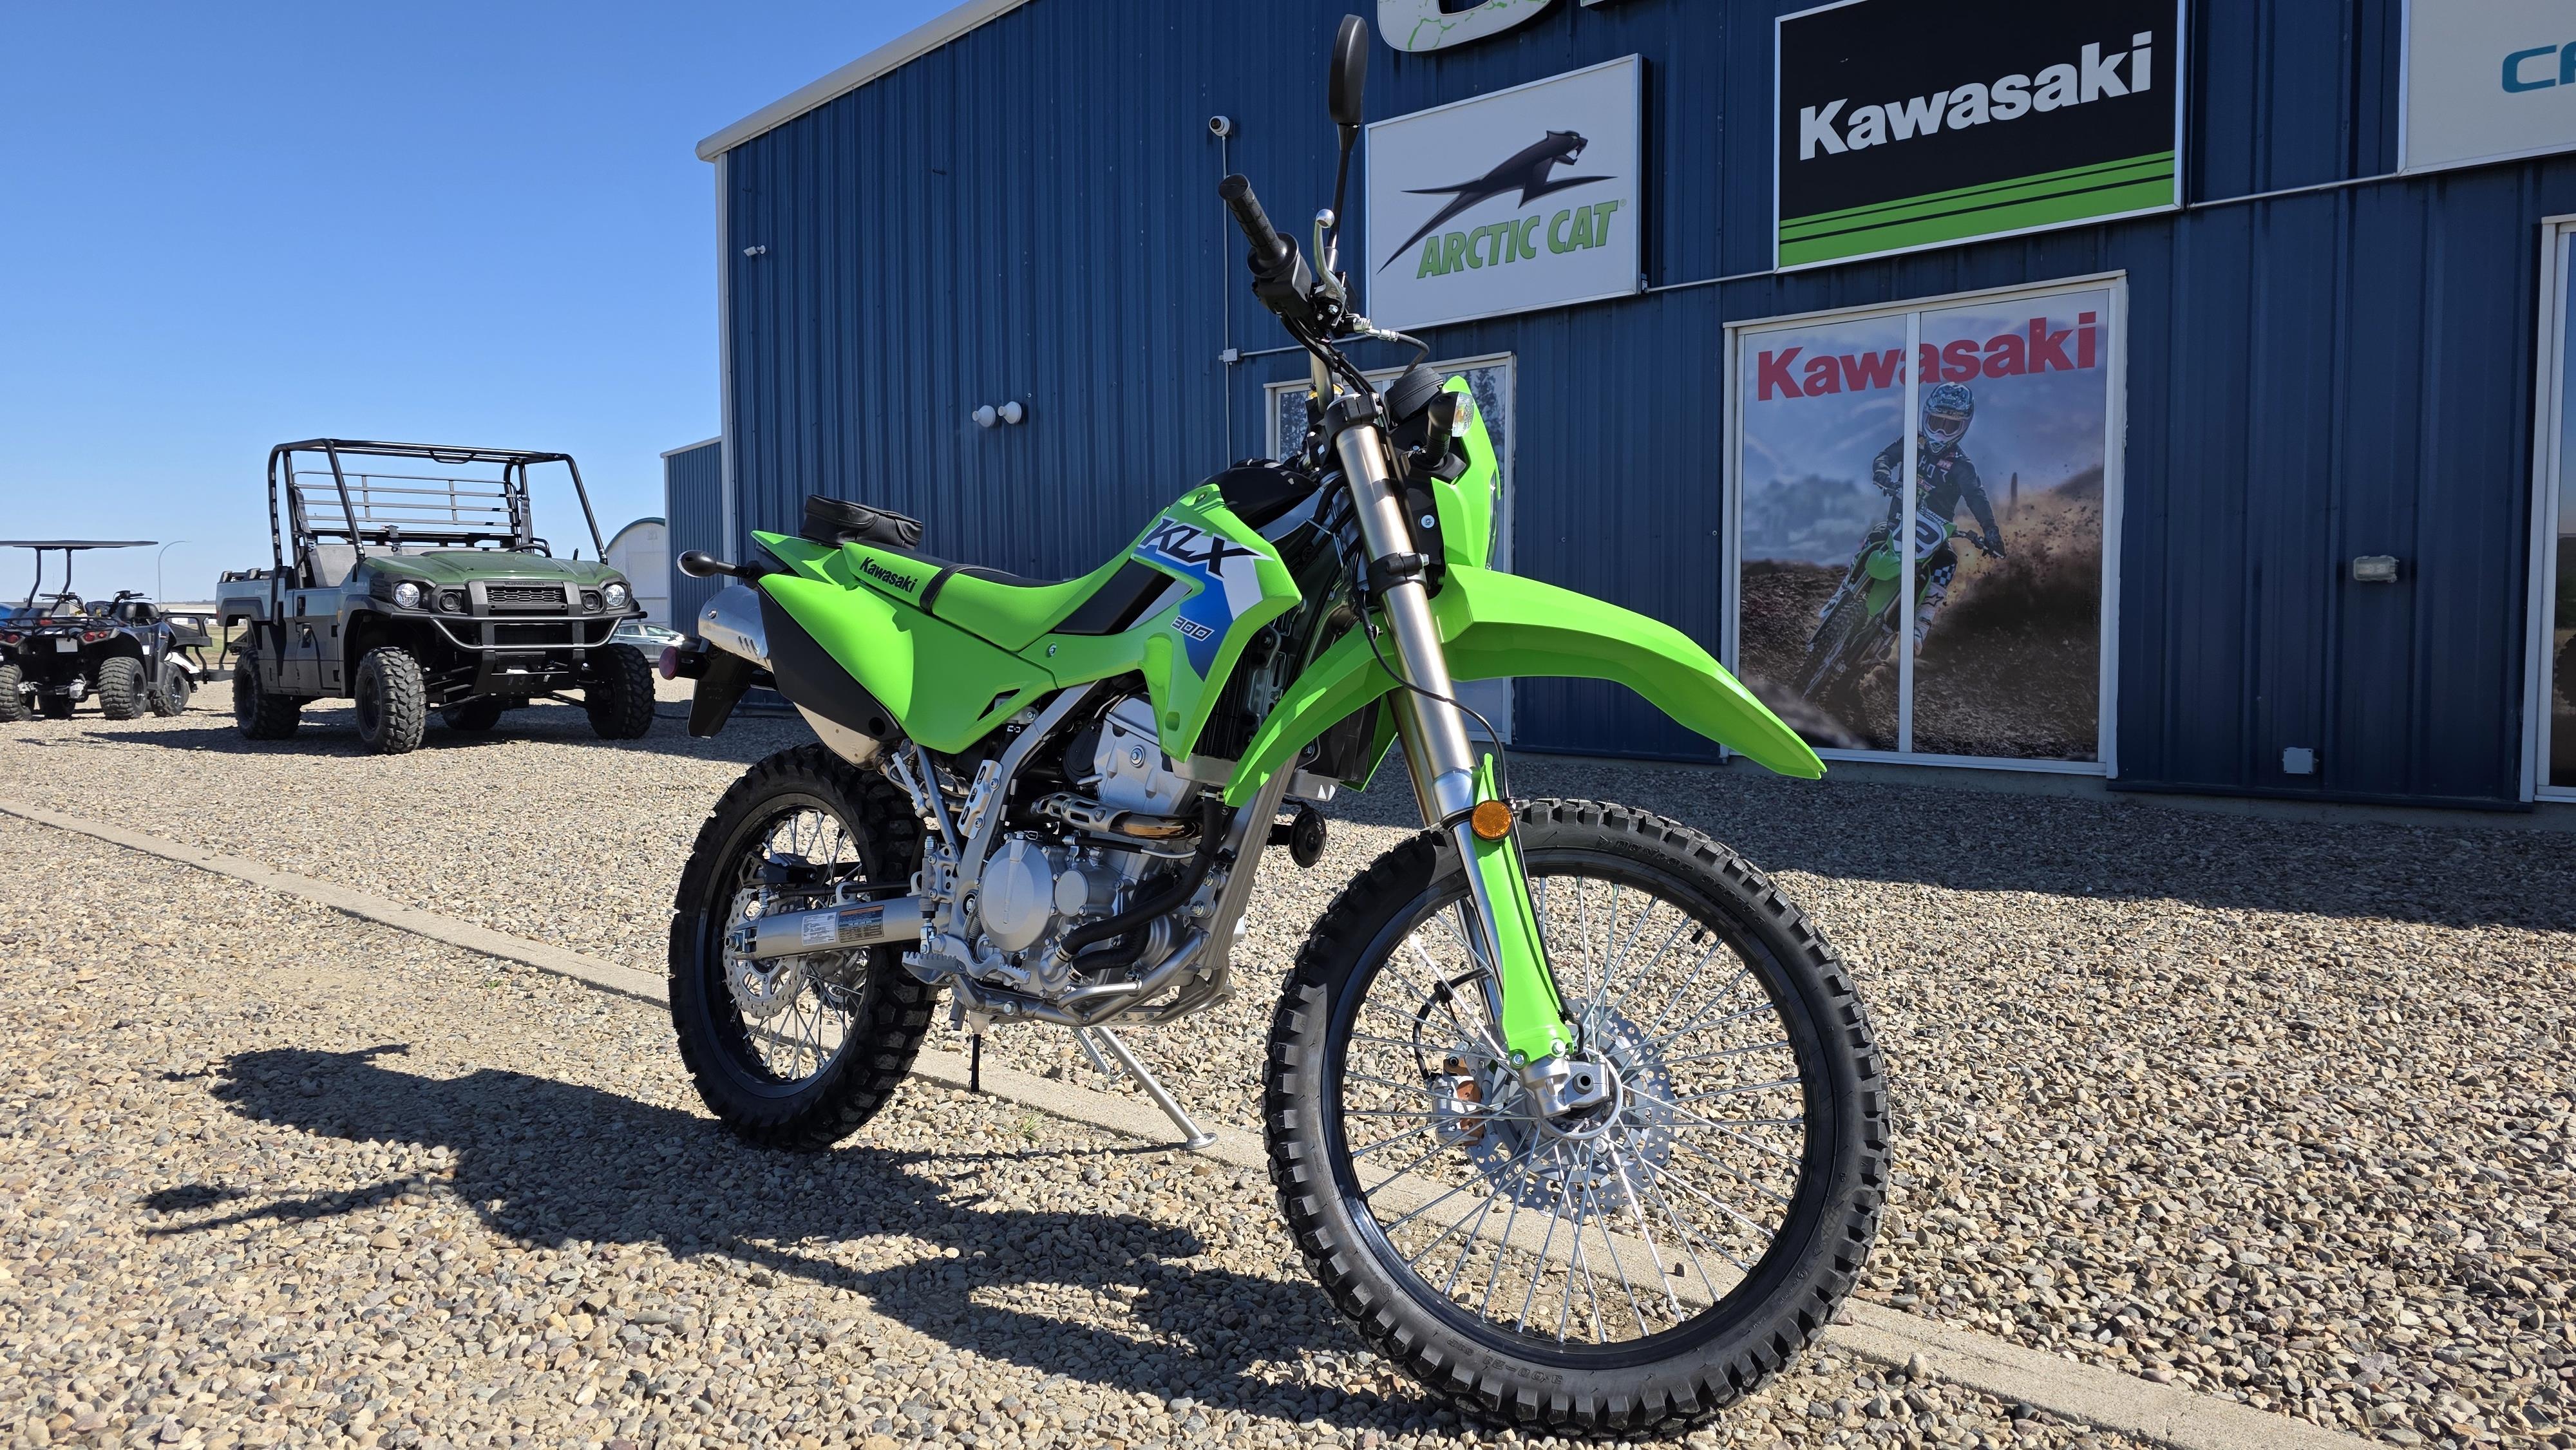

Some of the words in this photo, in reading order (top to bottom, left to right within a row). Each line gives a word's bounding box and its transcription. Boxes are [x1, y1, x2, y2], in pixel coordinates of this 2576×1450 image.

[1800, 30, 2152, 161] Kawasaki
[1416, 215, 1540, 279] ARCTIC
[1548, 200, 1619, 254] CAT
[1757, 311, 2097, 402] Kawasaki
[859, 556, 918, 593] Kawasaki
[1140, 517, 1265, 580] KLX
[1171, 616, 1214, 641] 300
[1615, 839, 1695, 871] DUNLOP
